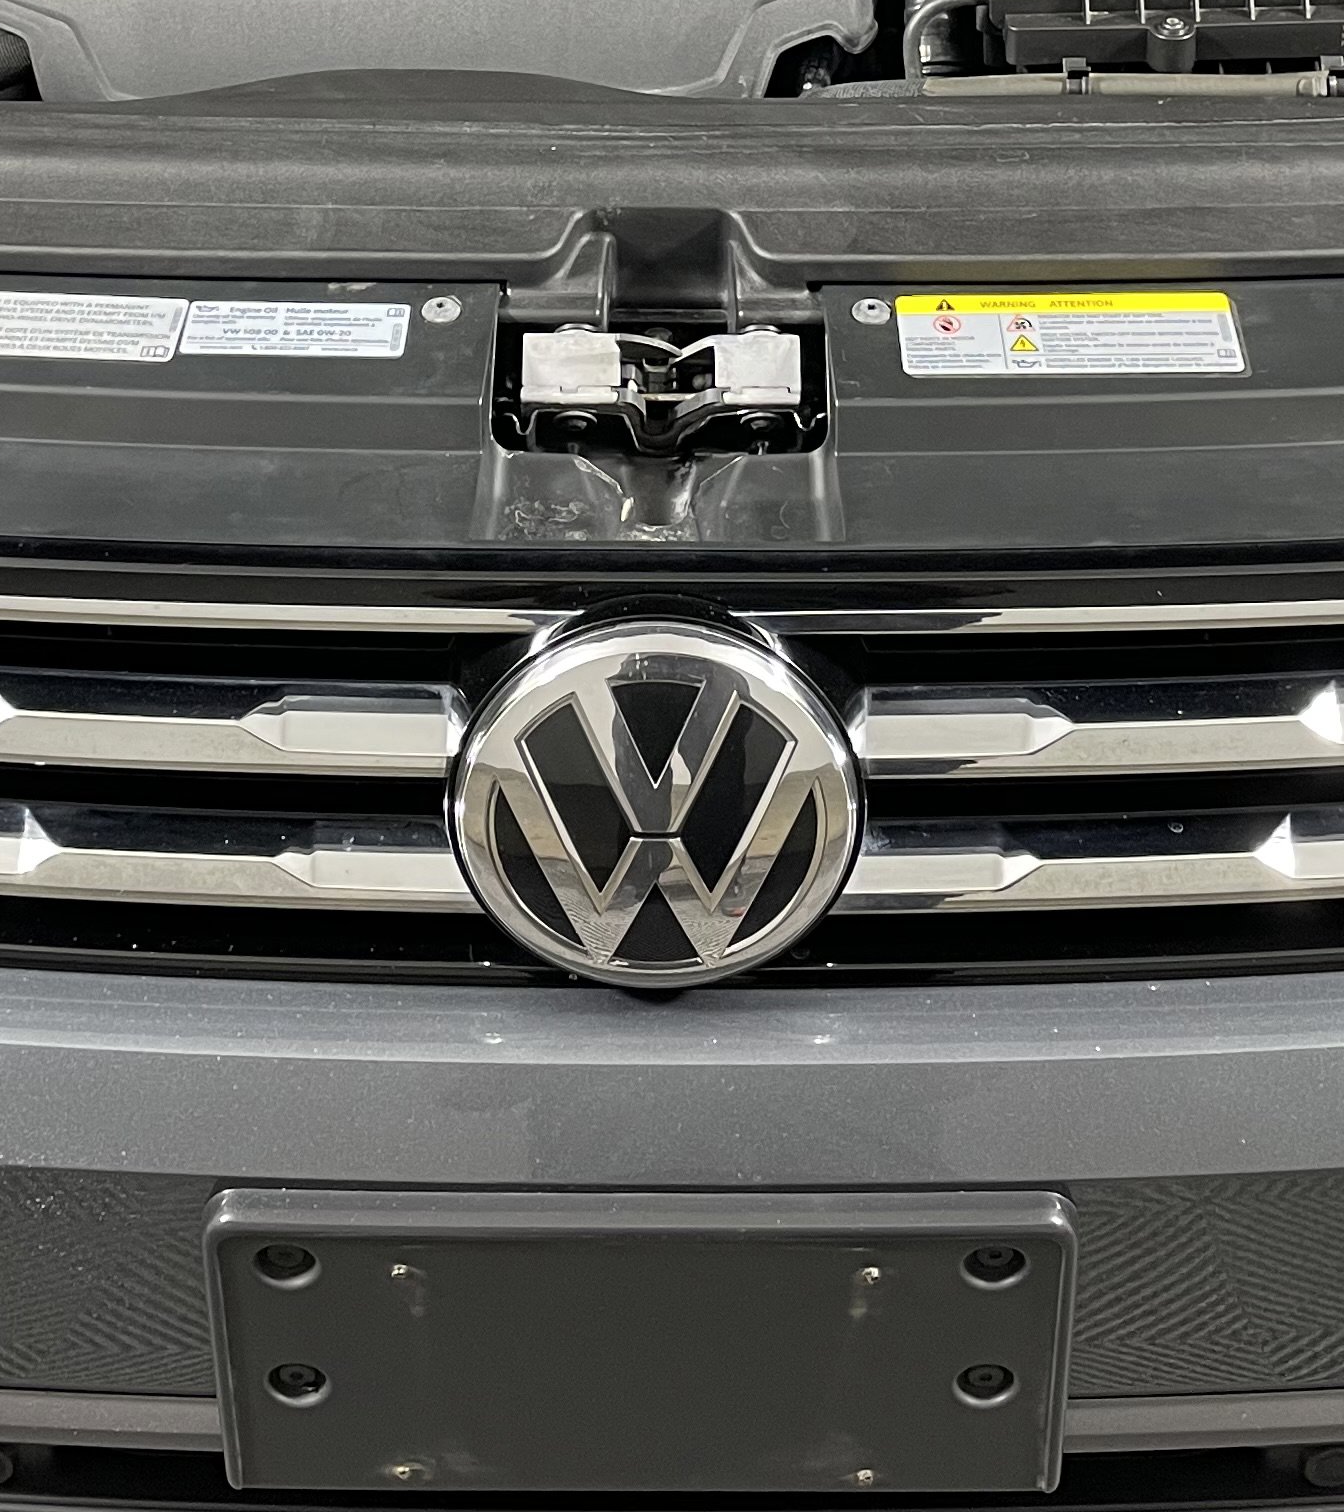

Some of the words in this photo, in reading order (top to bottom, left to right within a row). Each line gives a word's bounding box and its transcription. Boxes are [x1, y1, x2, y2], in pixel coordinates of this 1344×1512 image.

[979, 299, 1037, 310] WARNING
[1049, 298, 1114, 309] ATTENTION
[229, 306, 263, 315] Engine
[285, 307, 312, 315] Huile
